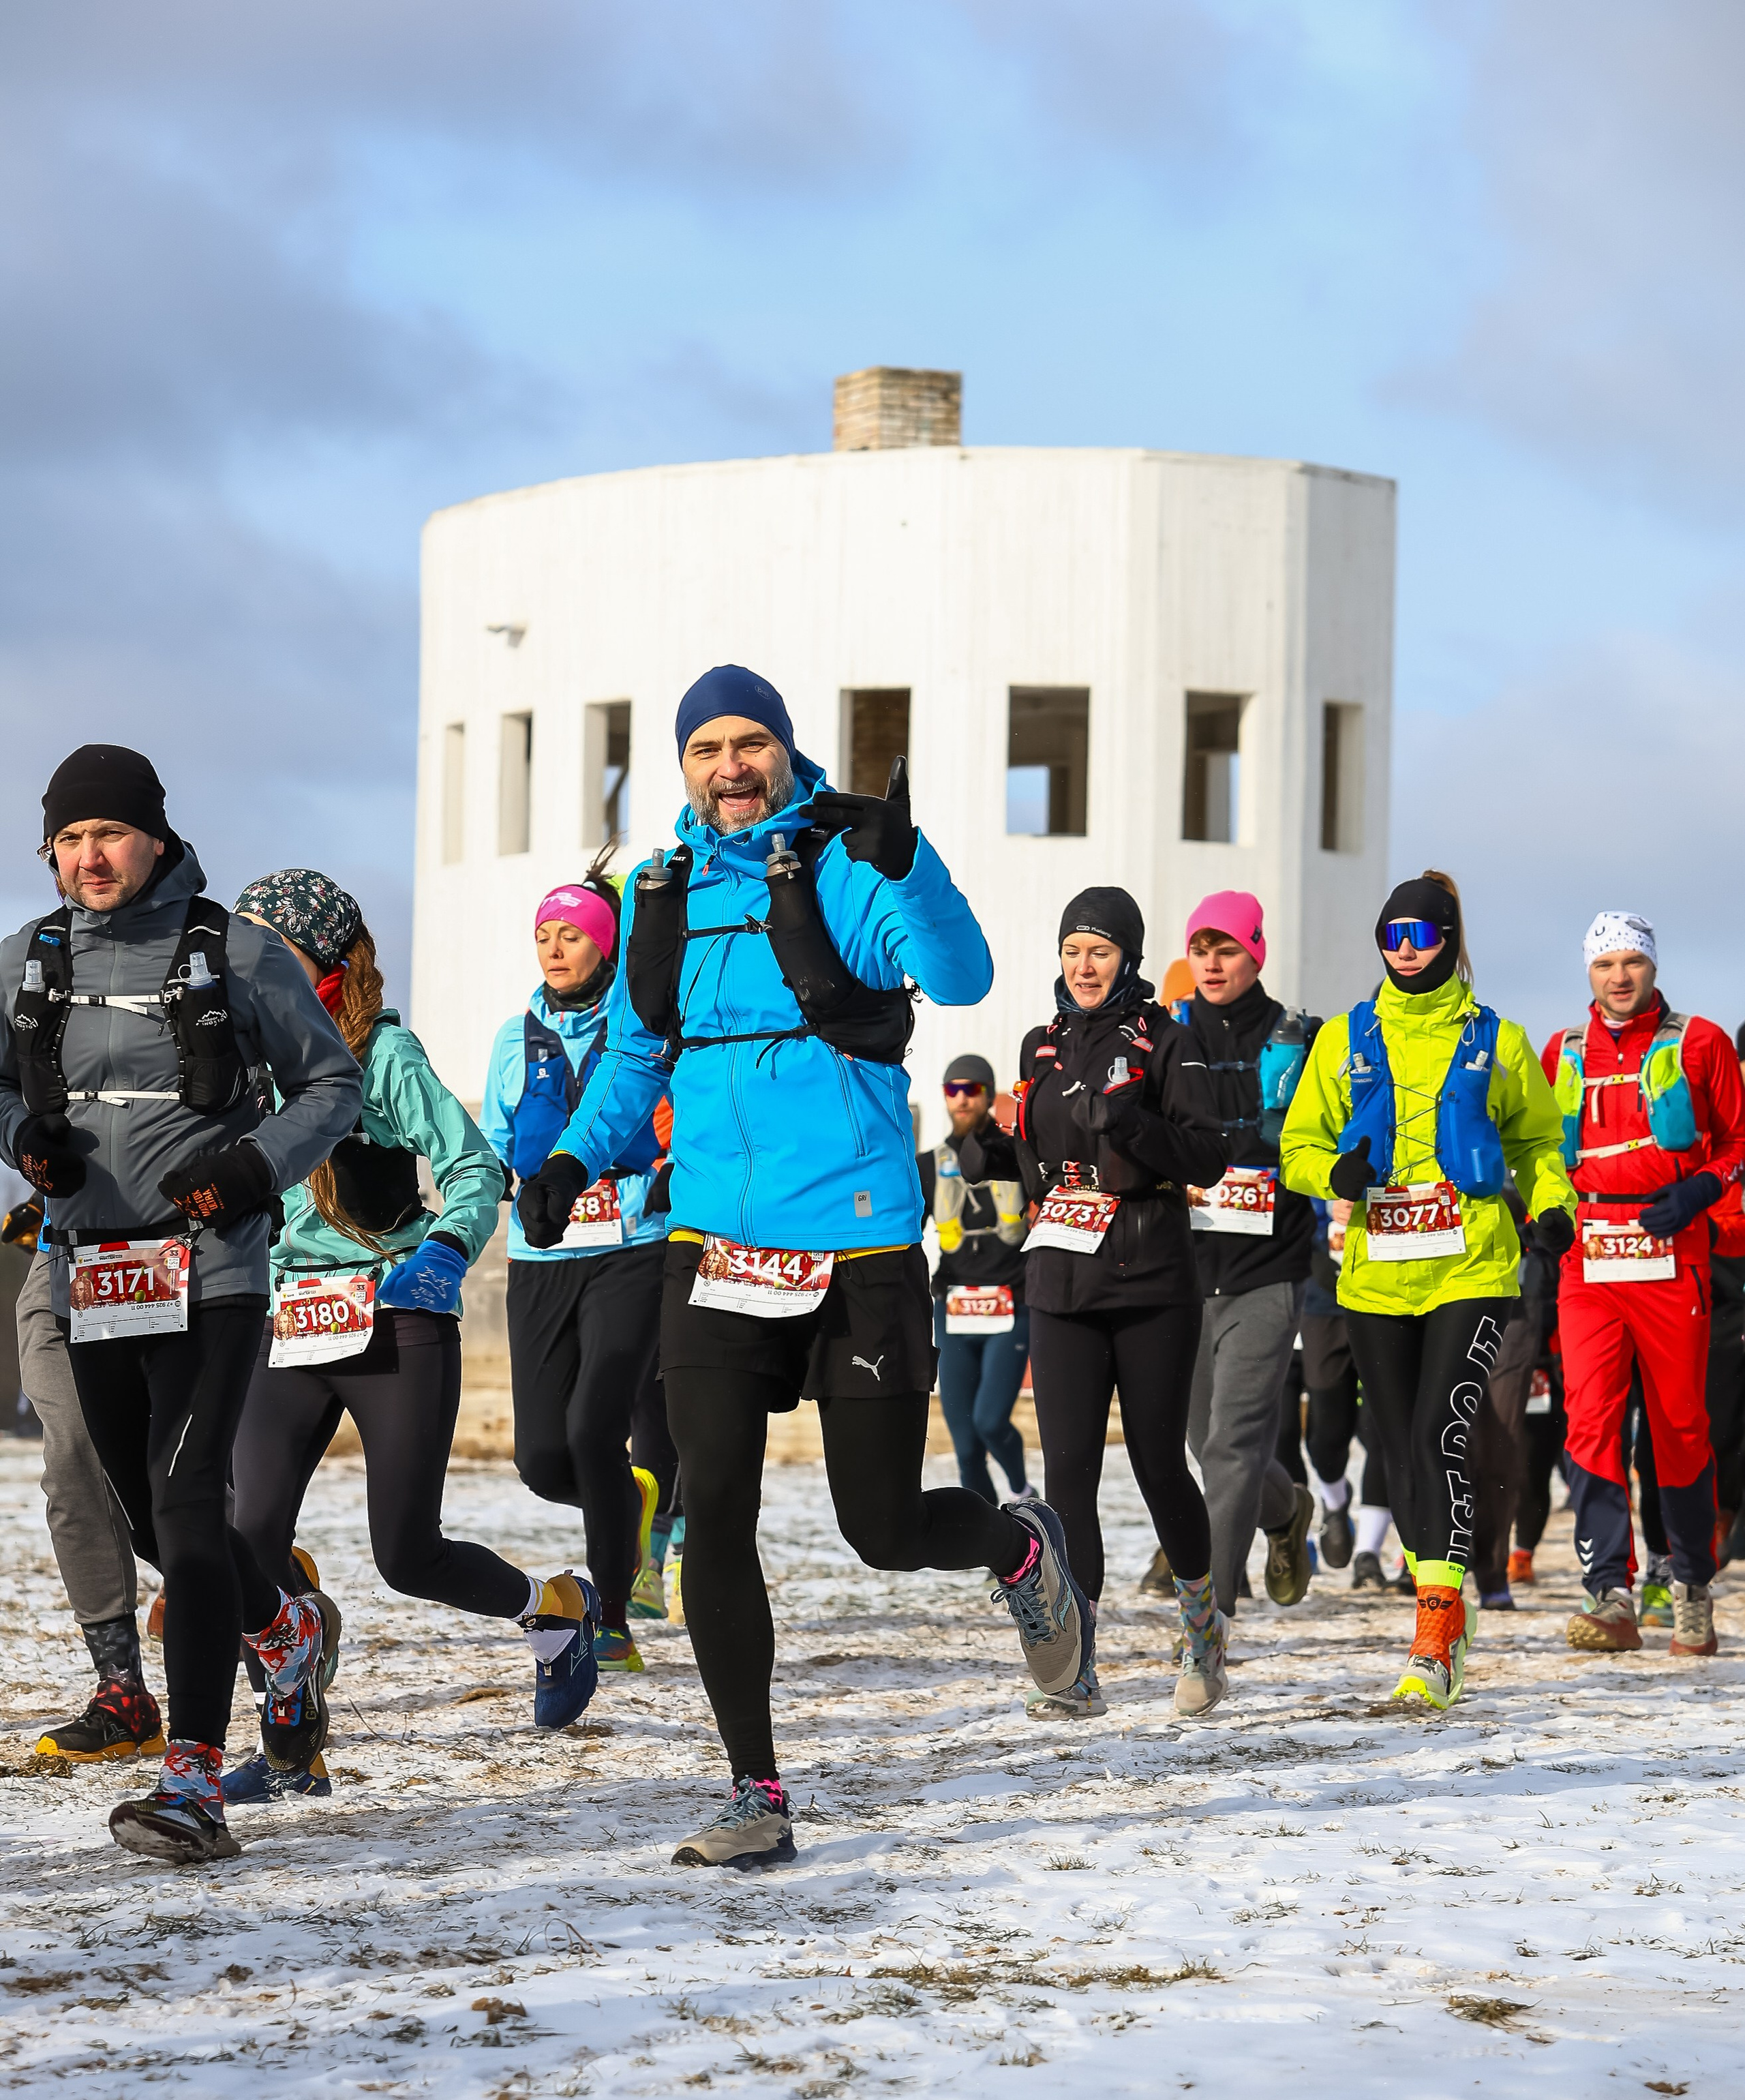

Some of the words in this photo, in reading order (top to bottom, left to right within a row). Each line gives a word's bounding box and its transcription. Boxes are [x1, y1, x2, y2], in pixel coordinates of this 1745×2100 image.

[192, 1189, 204, 1203] FOX
[202, 1188, 218, 1210] ULTRA
[573, 1196, 601, 1216] 38
[1040, 1201, 1095, 1222] 3073
[1380, 1203, 1440, 1227] 3077
[1603, 1235, 1653, 1255] 3124
[730, 1250, 803, 1280] 3144
[97, 1268, 155, 1296] 3171
[295, 1300, 350, 1330] 3180
[1440, 1381, 1483, 1460] DO
